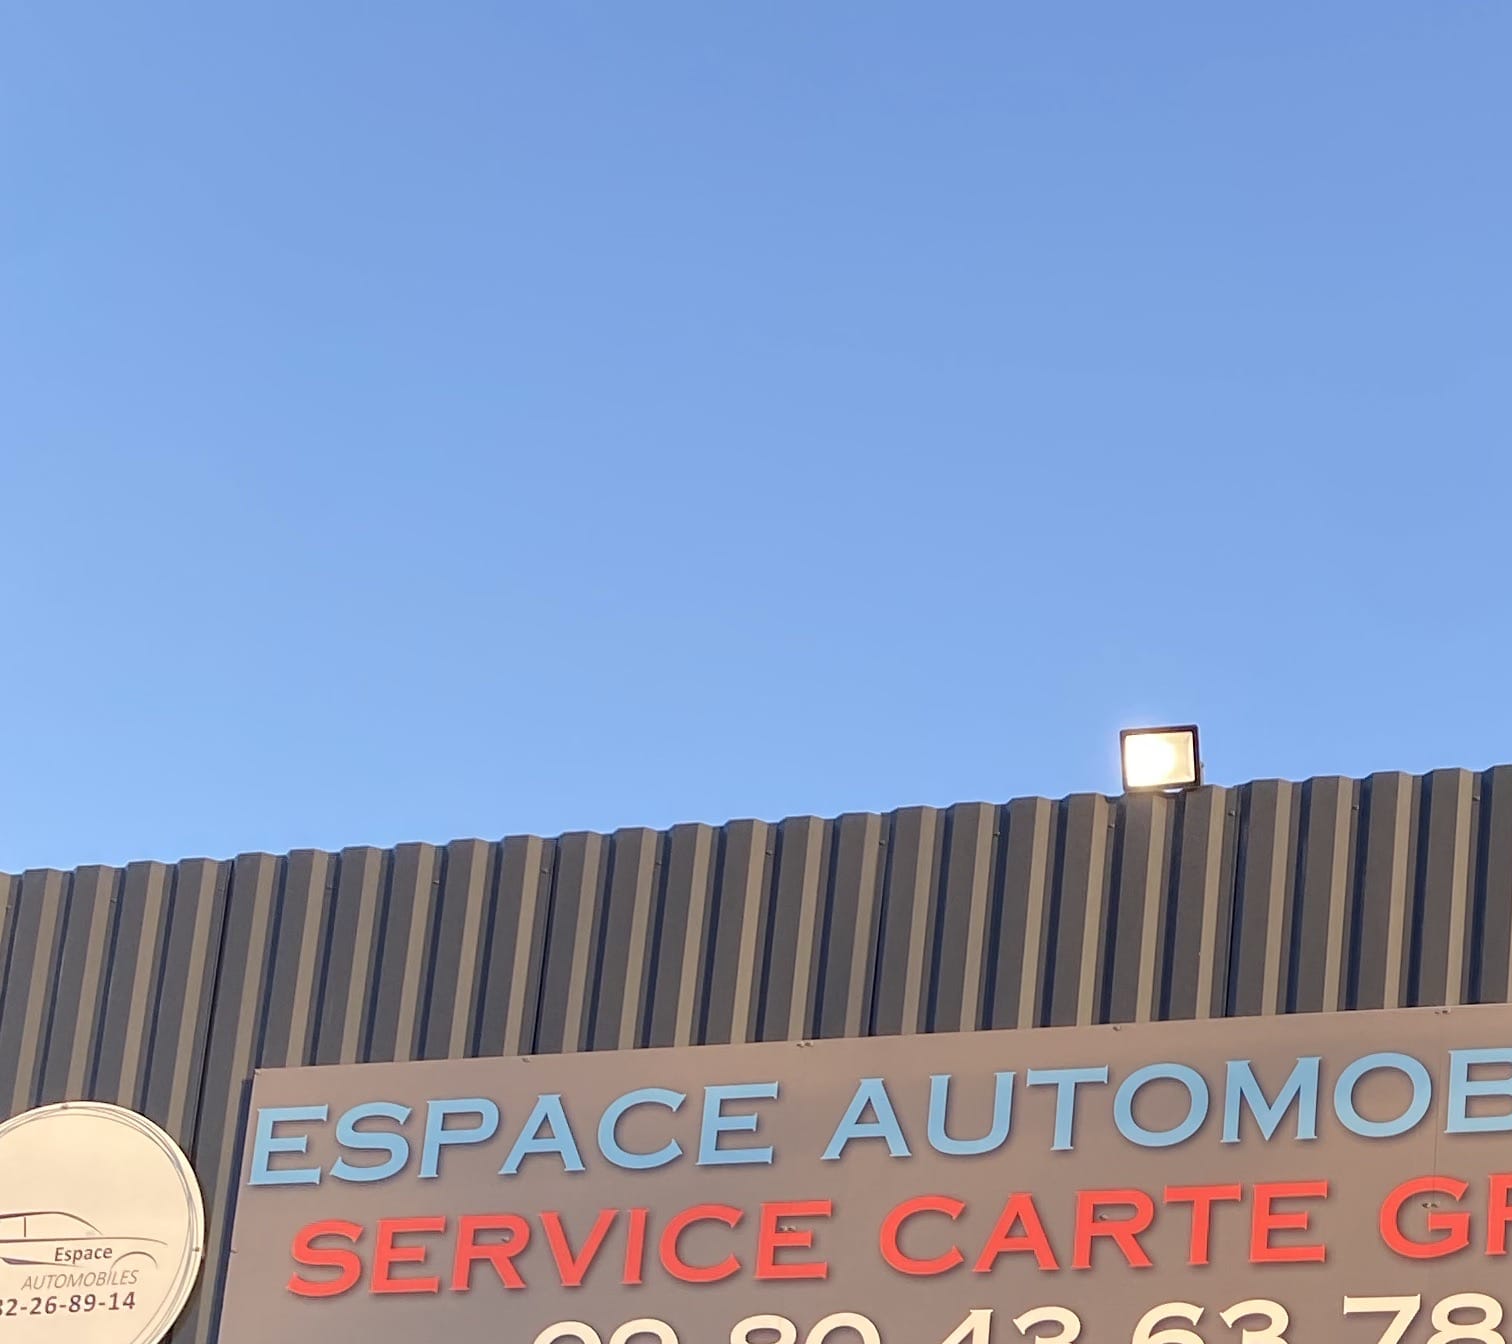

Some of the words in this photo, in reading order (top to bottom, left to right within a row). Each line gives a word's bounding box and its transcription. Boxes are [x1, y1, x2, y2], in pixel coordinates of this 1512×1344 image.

[246, 1080, 780, 1186] ESPACE
[286, 1199, 832, 1298] SERVICE
[879, 1180, 1329, 1275] CARTE
[54, 1246, 113, 1264] Espace
[20, 1269, 139, 1290] AUTOMOBILES
[0, 1291, 136, 1316] 2-26-89-14
